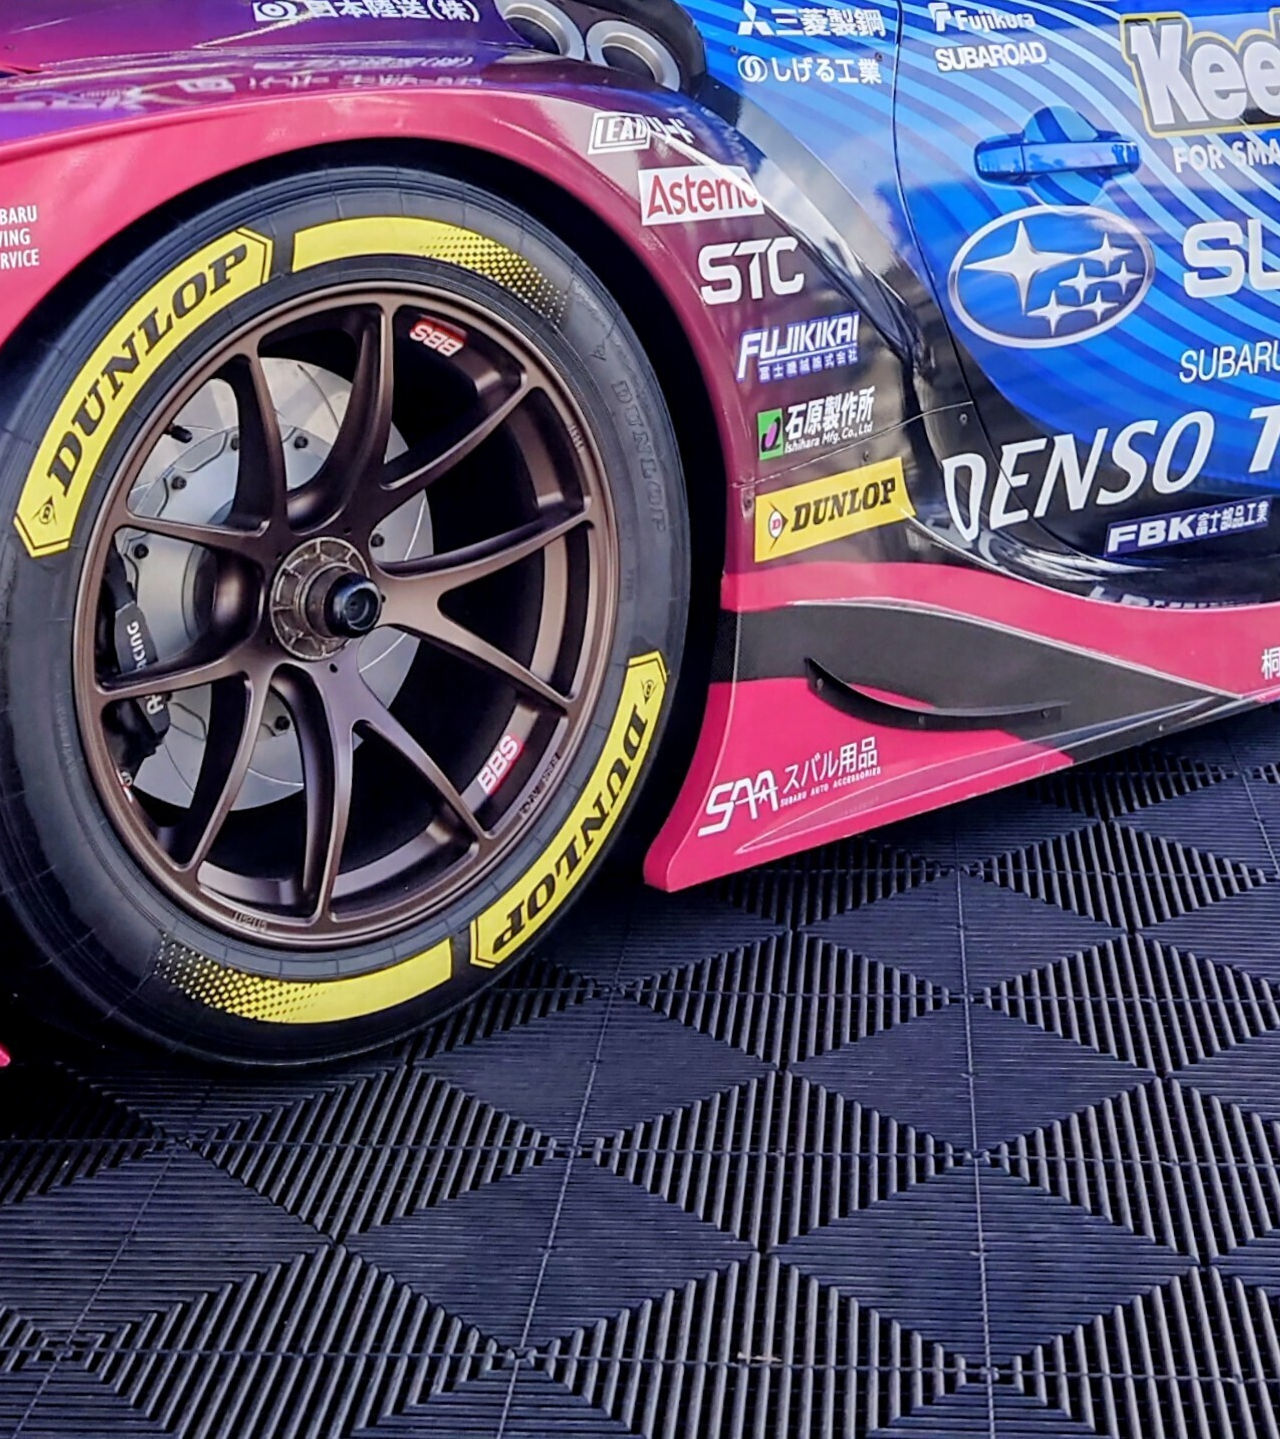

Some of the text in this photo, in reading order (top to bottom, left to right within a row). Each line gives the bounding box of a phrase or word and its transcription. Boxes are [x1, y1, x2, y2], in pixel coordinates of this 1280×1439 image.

[772, 9, 886, 37] 三菱製鋼
[954, 9, 1036, 32] Fujikura
[772, 57, 882, 84] しげる工業
[935, 41, 1047, 72] SUBAROAD
[1174, 144, 1223, 173] FOR
[698, 236, 804, 305] STC
[410, 324, 464, 357] BBS
[737, 314, 859, 380] FUJIKIKAI
[47, 241, 248, 497] DUNLOP
[785, 386, 876, 440] 石原製作所
[941, 411, 1215, 542] DENSO
[791, 478, 896, 533] DUNLOP
[1107, 514, 1196, 553] FBK
[476, 735, 519, 795] BBS
[783, 736, 877, 794] スバル用品
[493, 701, 648, 952] DUNLOP
